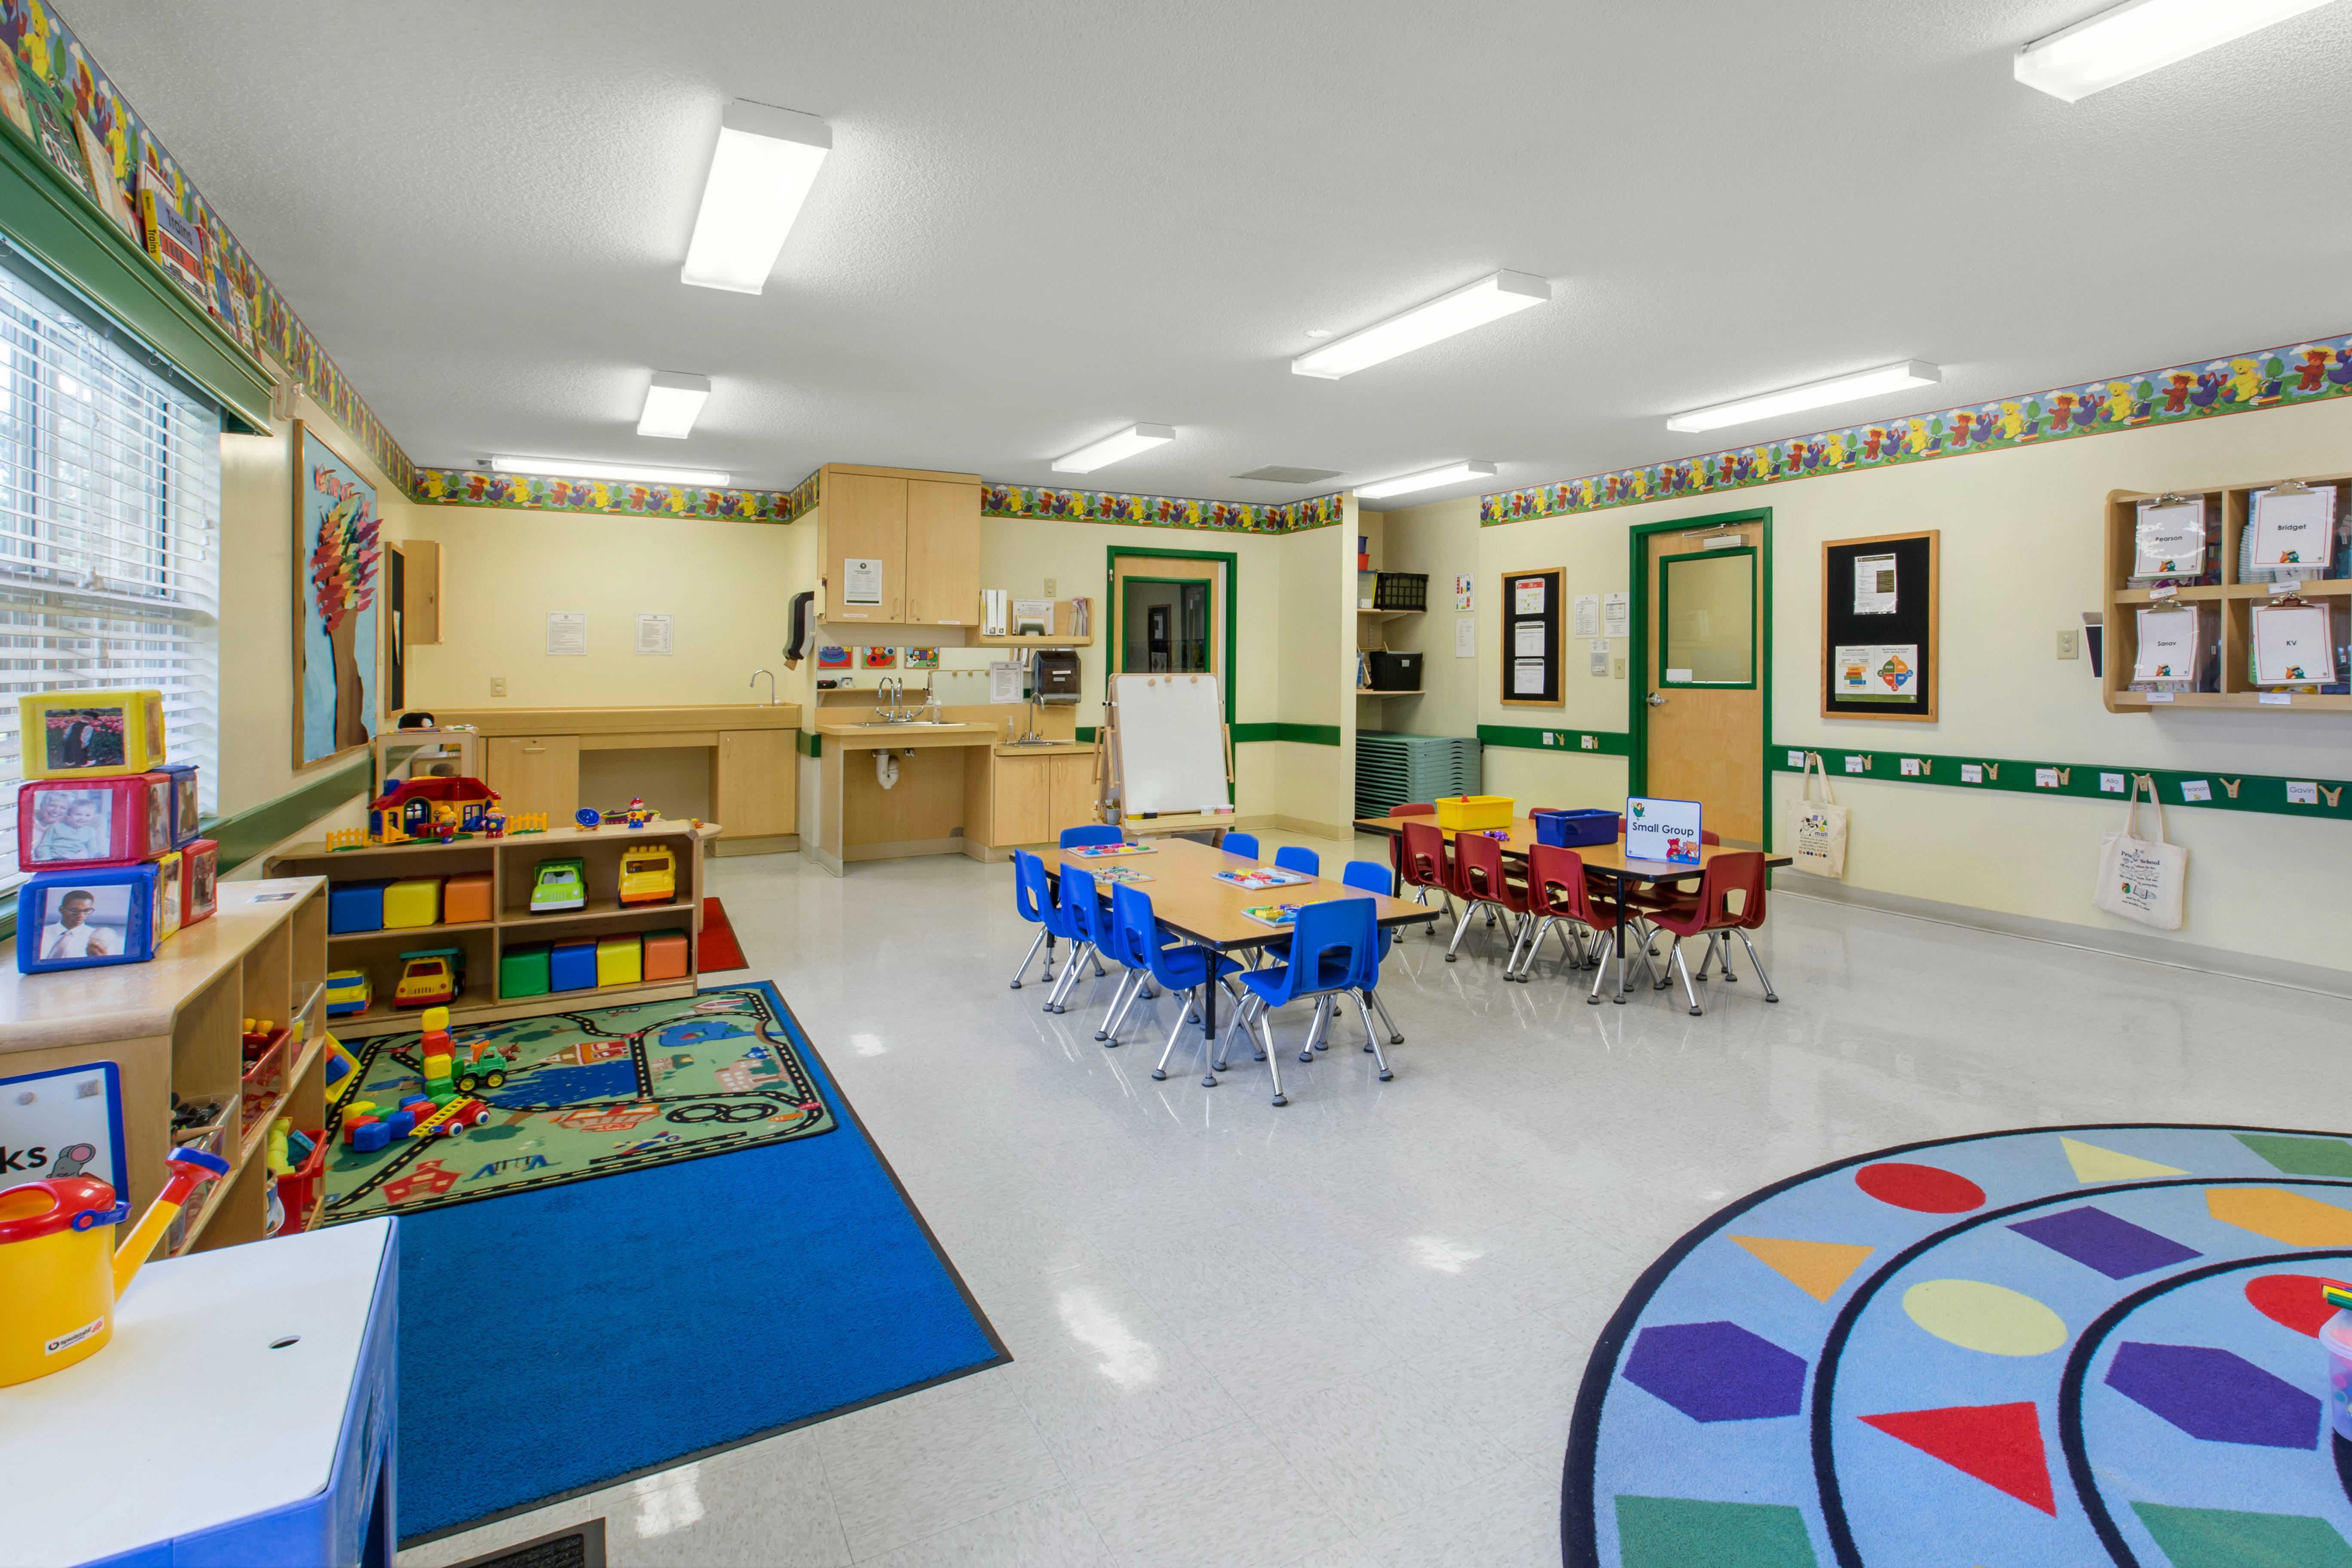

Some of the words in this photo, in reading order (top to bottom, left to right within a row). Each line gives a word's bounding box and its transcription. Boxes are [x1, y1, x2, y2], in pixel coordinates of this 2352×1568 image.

[166, 208, 193, 245] Trains
[147, 229, 157, 254] Trains
[1632, 822, 1659, 833] Small
[1662, 825, 1694, 838] Group
